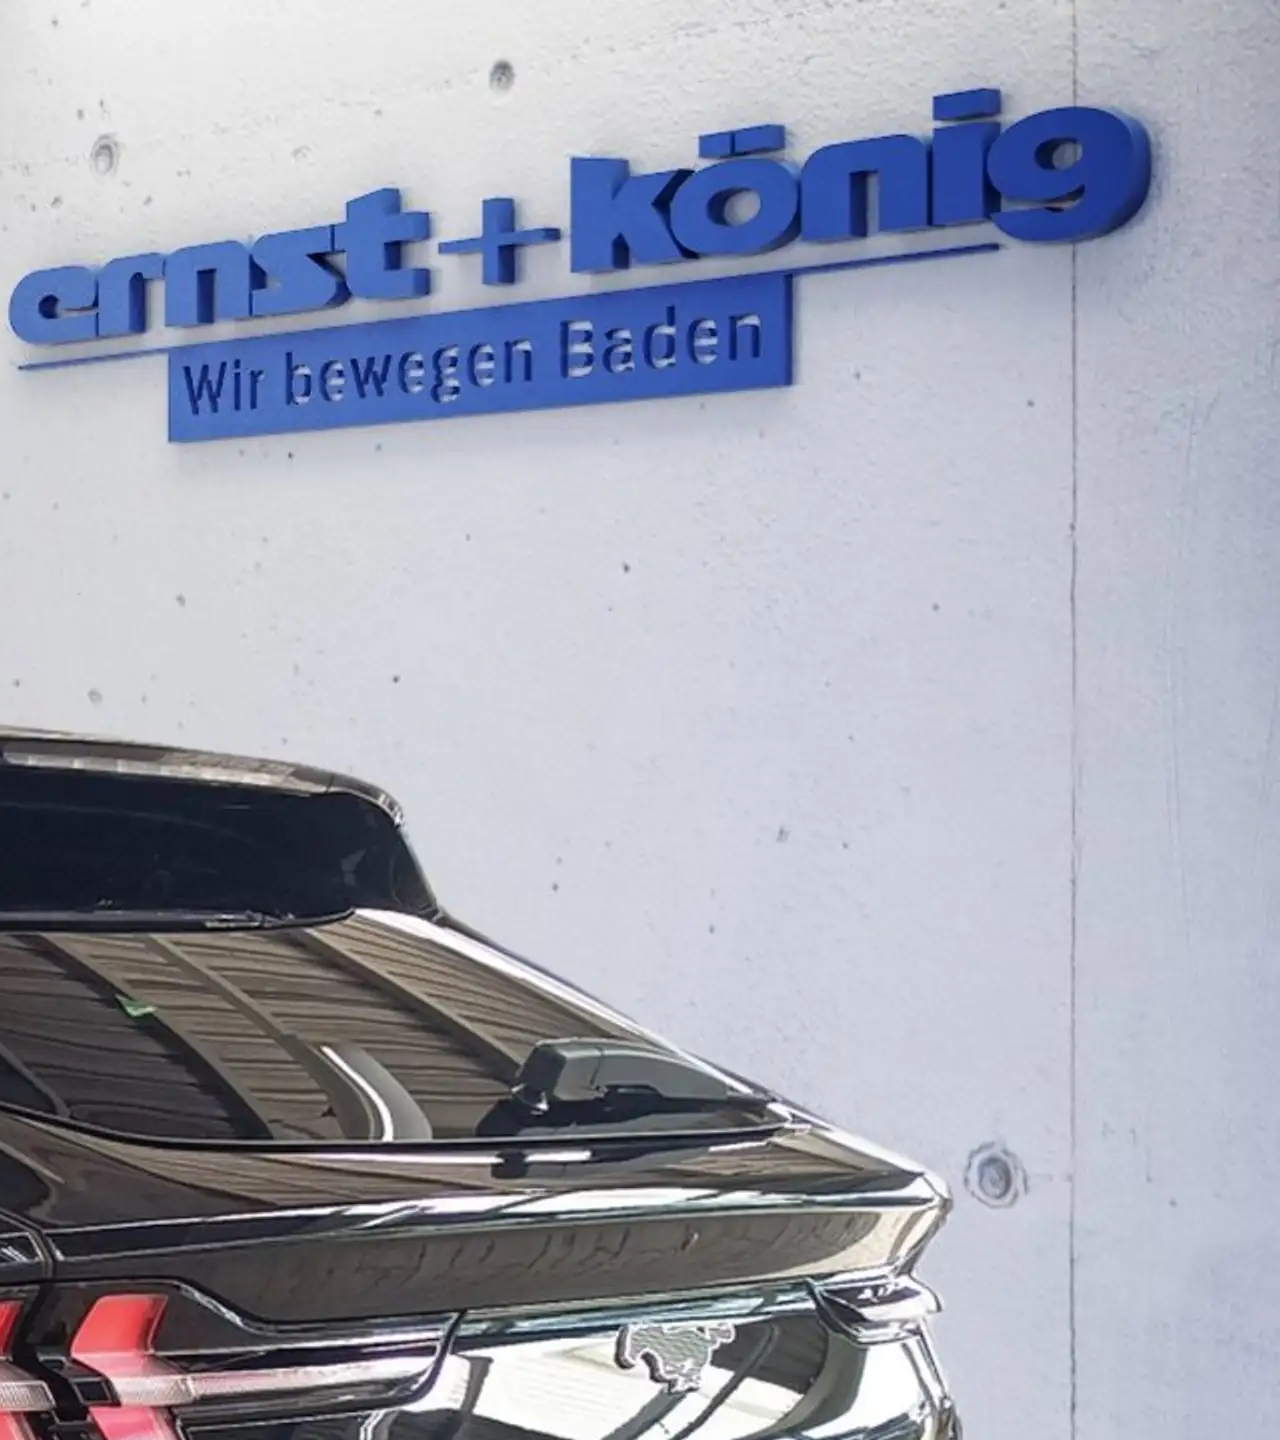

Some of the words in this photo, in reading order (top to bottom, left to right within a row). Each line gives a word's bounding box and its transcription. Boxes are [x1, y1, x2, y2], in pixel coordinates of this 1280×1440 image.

[183, 359, 264, 415] Wir
[284, 337, 533, 402] bewegen
[559, 306, 762, 378] Baden
